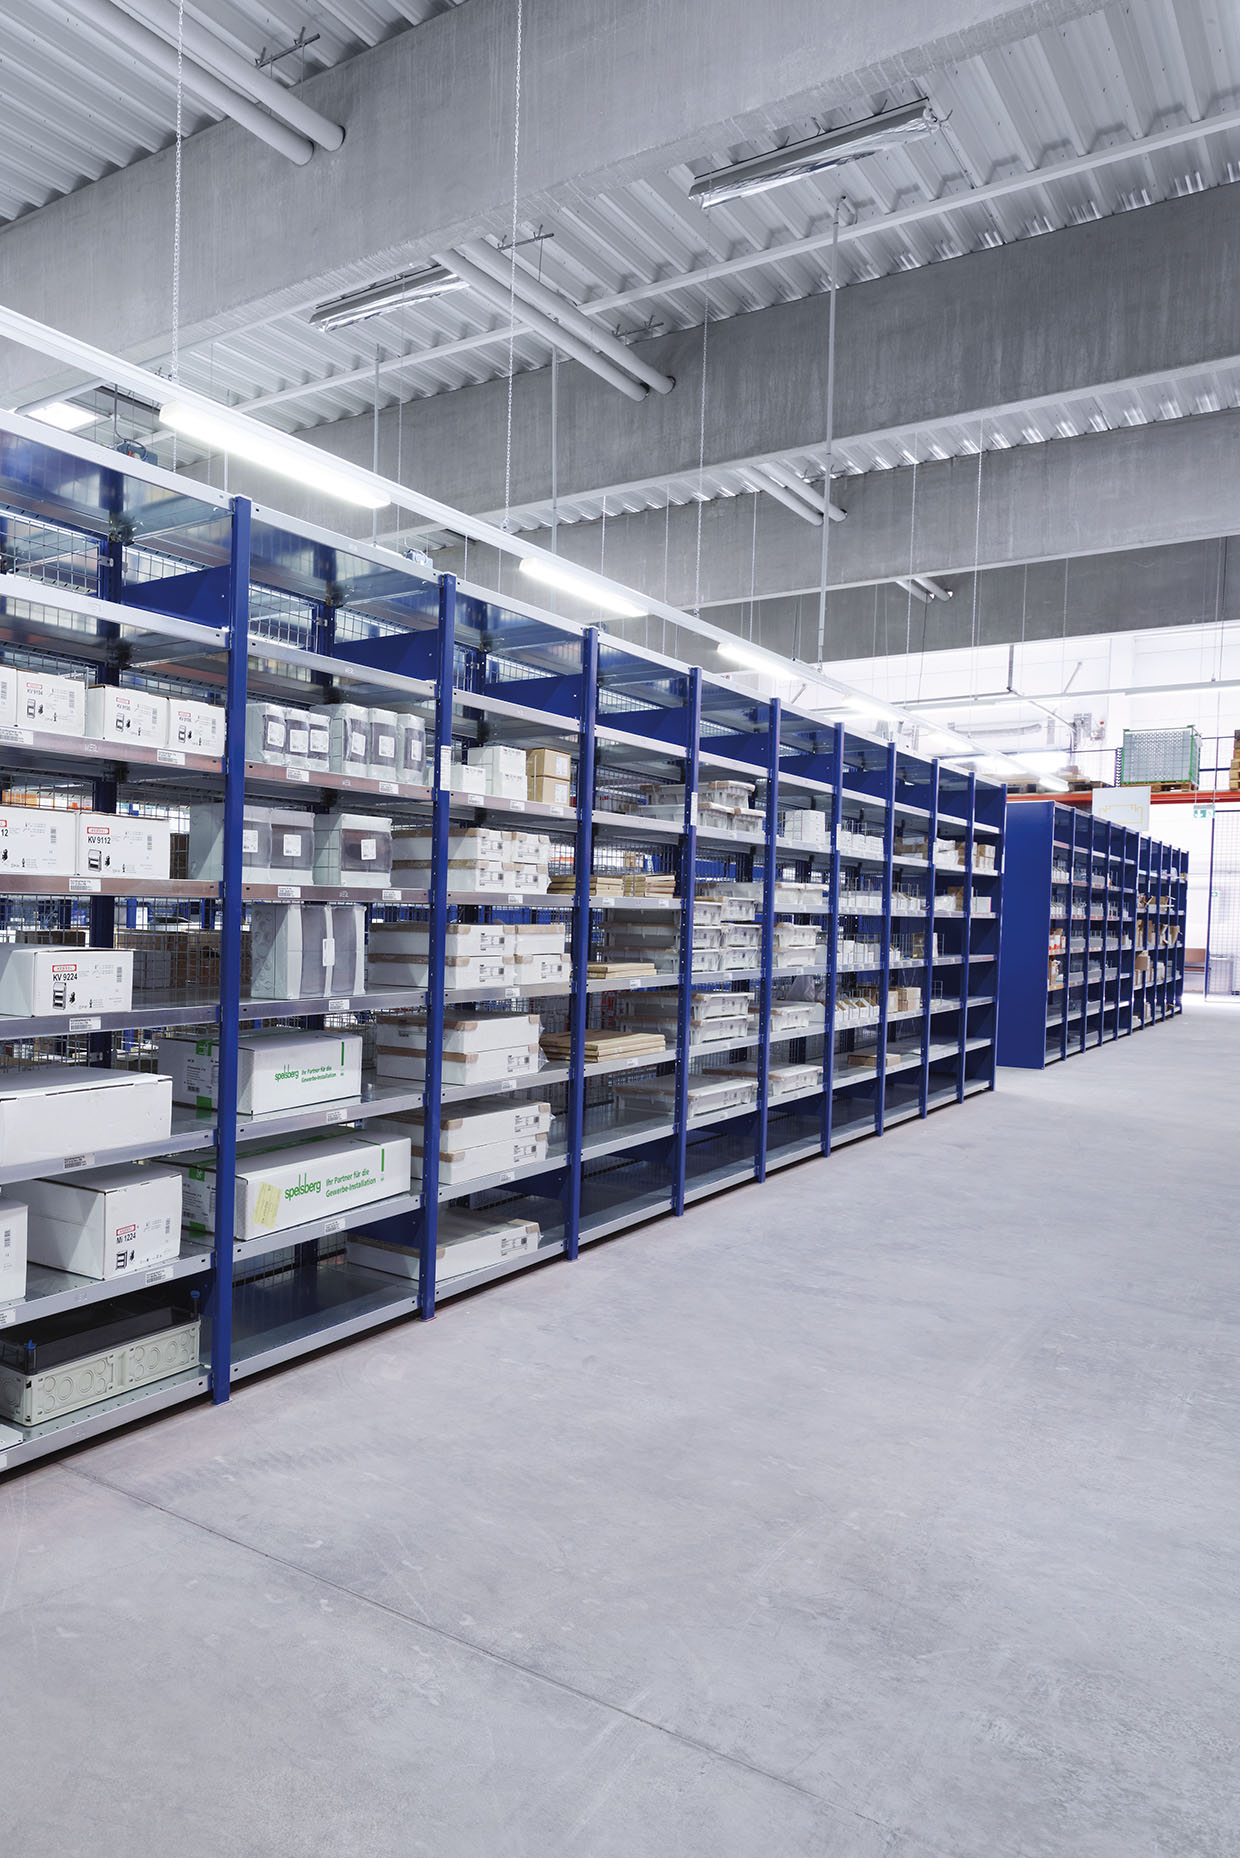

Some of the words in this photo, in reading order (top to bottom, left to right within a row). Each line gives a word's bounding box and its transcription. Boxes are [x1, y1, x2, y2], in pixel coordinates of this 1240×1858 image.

[88, 836, 96, 844] KV
[97, 836, 111, 844] 9112
[53, 973, 62, 981] KV
[63, 973, 78, 981] 9224
[274, 1064, 299, 1083] spelsberg
[284, 1172, 321, 1200] spelsberg
[334, 1174, 353, 1184] Partner
[353, 1170, 361, 1178] für
[326, 1178, 376, 1197] Gewerbe-Installation
[124, 1232, 136, 1241] 1224
